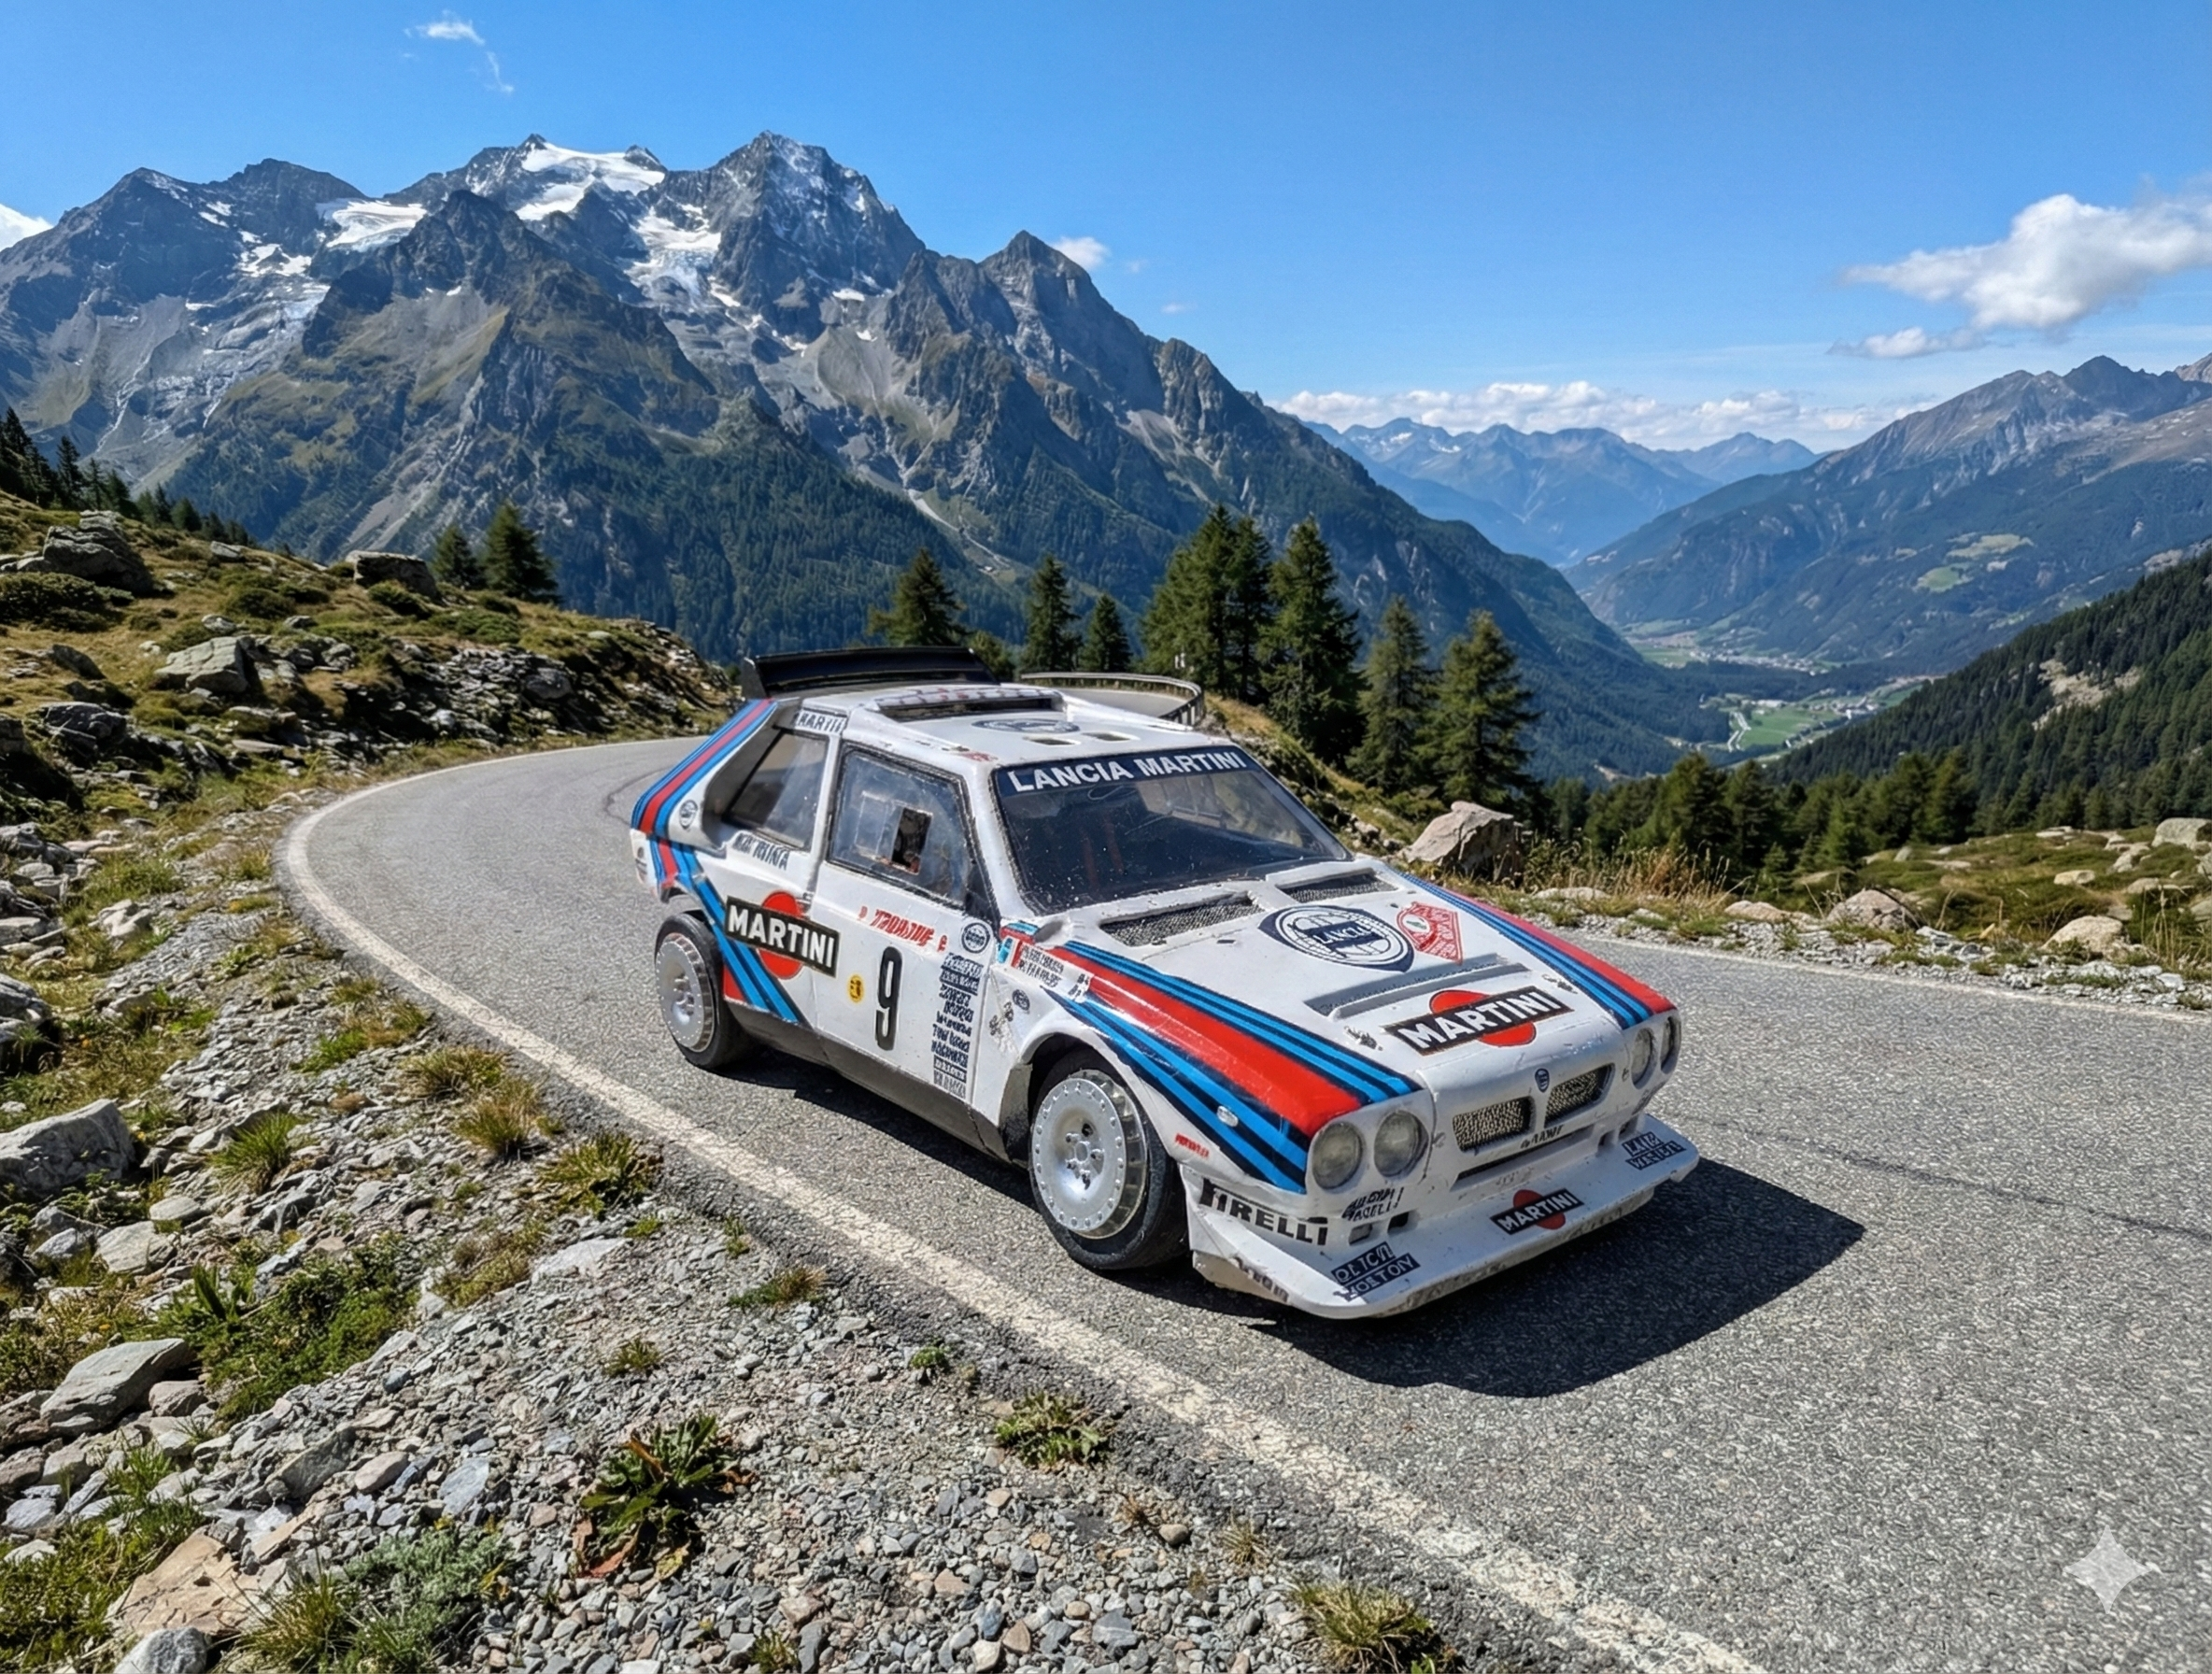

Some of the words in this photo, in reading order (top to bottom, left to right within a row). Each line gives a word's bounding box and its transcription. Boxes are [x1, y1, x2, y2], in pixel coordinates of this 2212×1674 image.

[1007, 760, 1134, 792] LANCIA
[1133, 751, 1247, 777] MARTINI
[728, 904, 835, 969] MARTINI
[875, 946, 902, 1051] 9
[1397, 990, 1561, 1049] MARTINI
[1496, 1191, 1579, 1231] MARTINI
